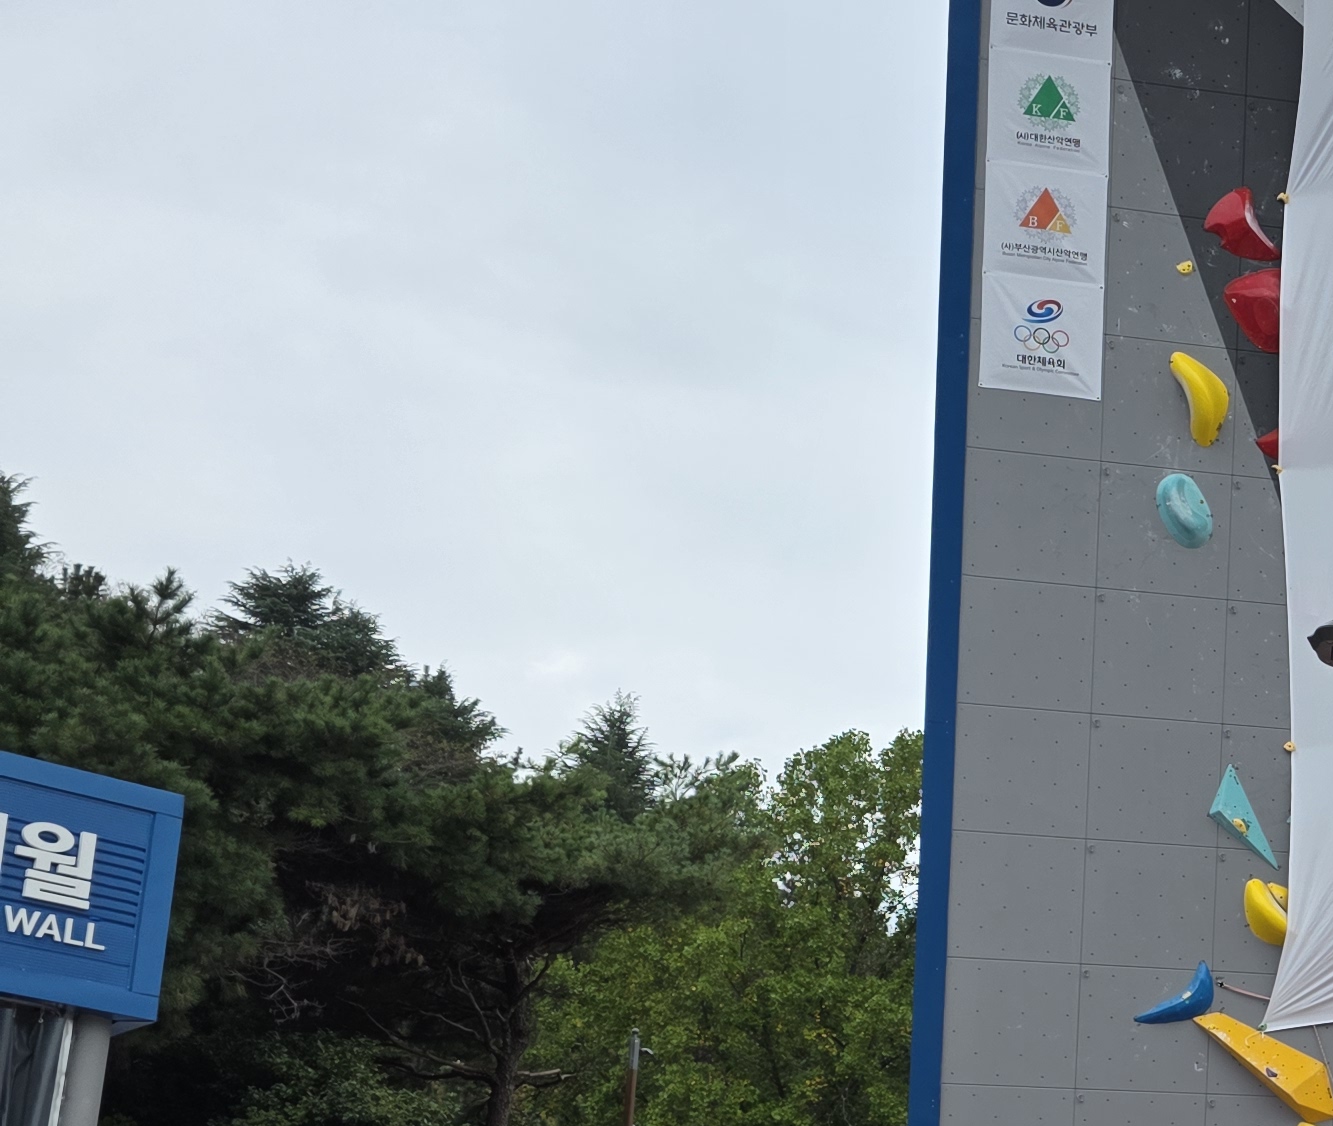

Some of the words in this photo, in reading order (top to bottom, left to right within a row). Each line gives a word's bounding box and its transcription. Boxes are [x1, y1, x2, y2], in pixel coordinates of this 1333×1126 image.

[1005, 12, 1098, 36] 문화체육관광부
[1032, 103, 1041, 116] K
[1059, 108, 1068, 119] F
[1016, 131, 1081, 147] (사)대한산악연맹
[1029, 215, 1038, 228] B
[1055, 220, 1065, 231] F
[1001, 242, 1088, 261] (사)부산광역시산악연맹
[1016, 354, 1066, 369] 대한체육회
[0, 812, 97, 910] 월
[5, 905, 106, 951] WALL
